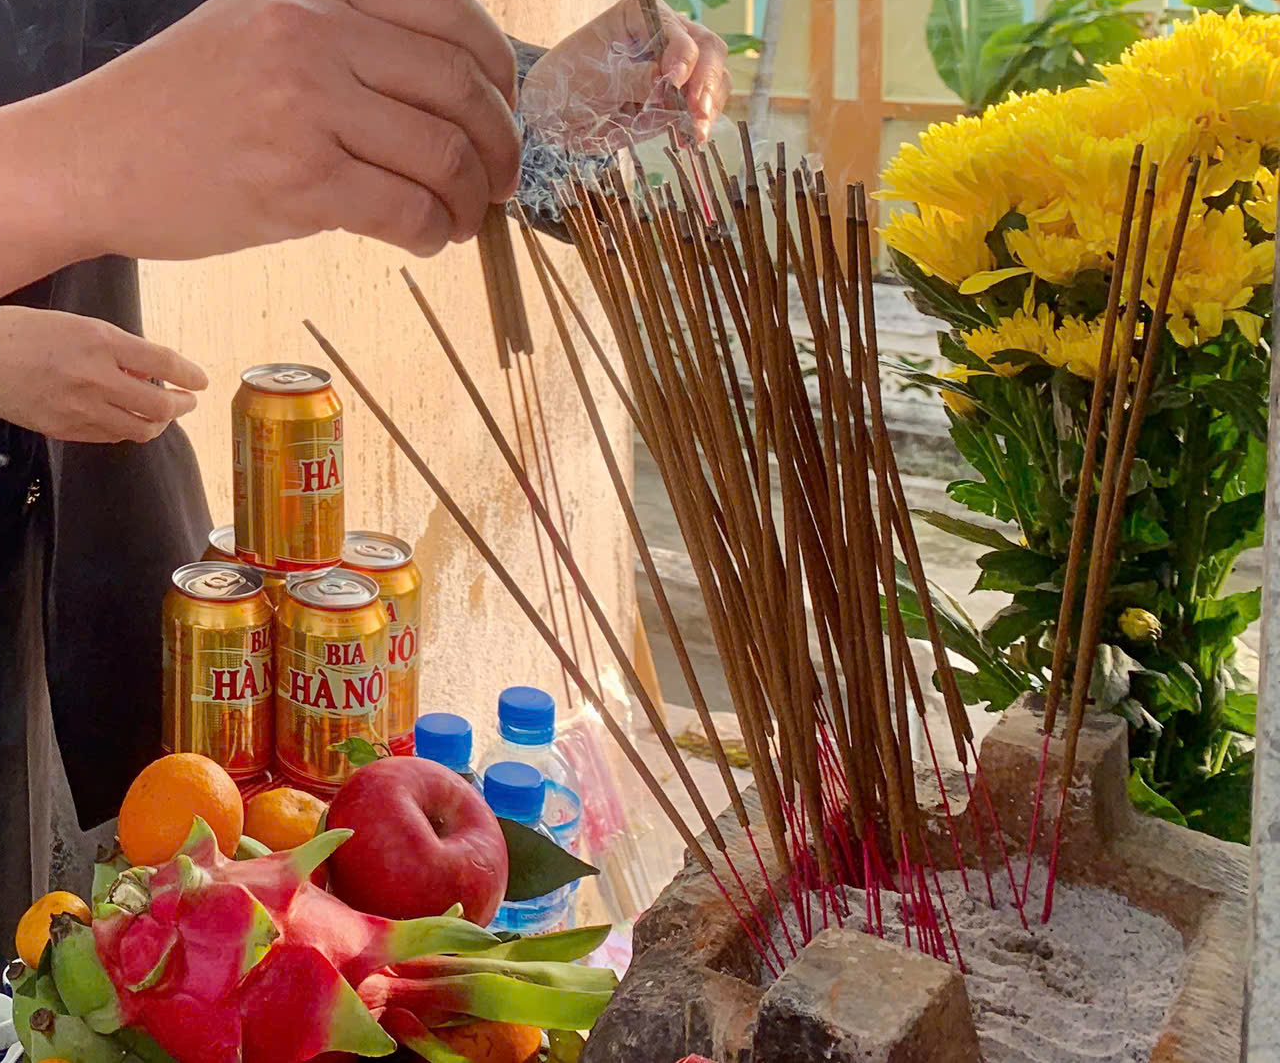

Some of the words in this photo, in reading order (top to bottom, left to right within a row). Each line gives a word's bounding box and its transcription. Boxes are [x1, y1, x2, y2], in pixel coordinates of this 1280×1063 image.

[301, 448, 341, 493] HÀ
[325, 642, 366, 666] BIA
[212, 659, 260, 701] HÀ
[289, 668, 338, 710] HÀ
